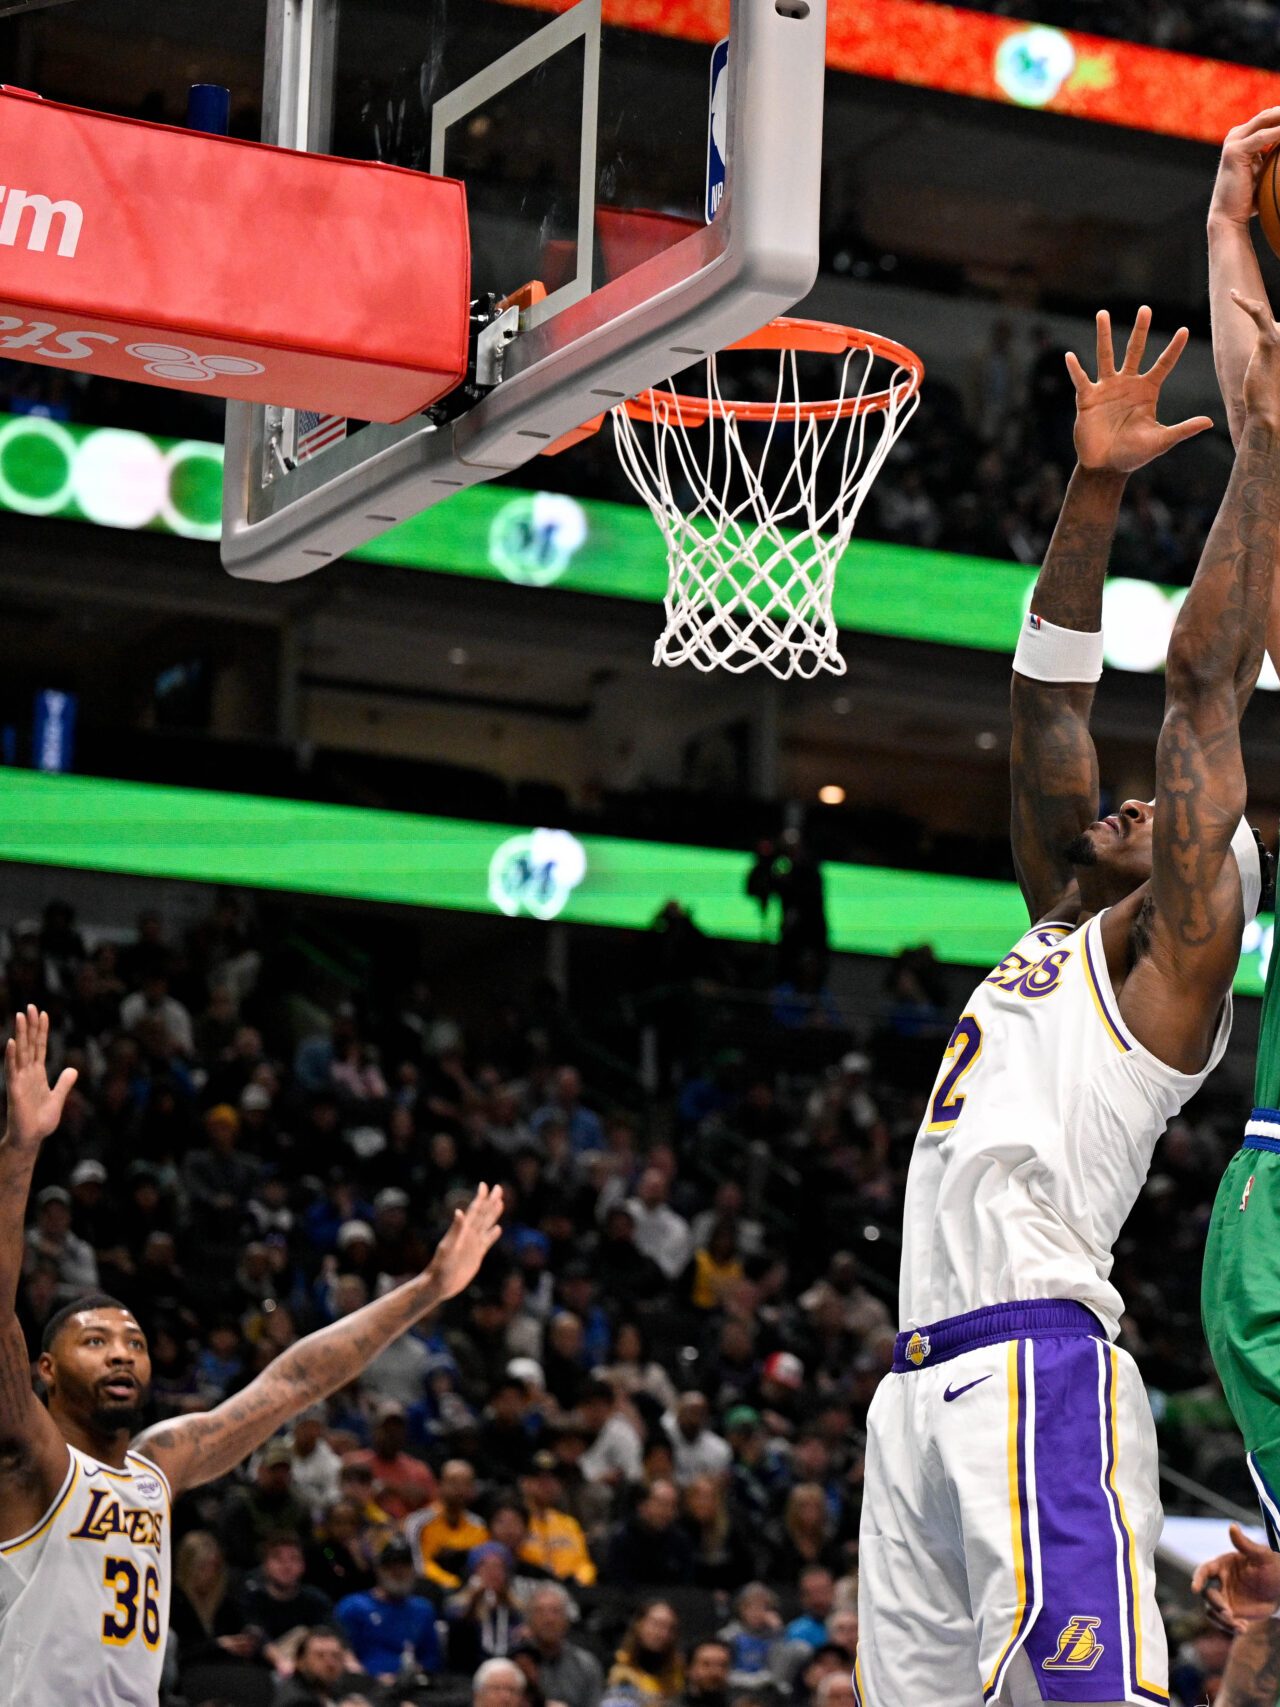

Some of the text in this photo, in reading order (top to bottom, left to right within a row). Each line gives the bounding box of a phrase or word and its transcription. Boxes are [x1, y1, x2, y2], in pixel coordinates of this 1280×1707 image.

[0, 185, 84, 259] m
[984, 950, 1074, 1000] ERS
[925, 1013, 984, 1133] 2
[102, 1555, 160, 1653] 36
